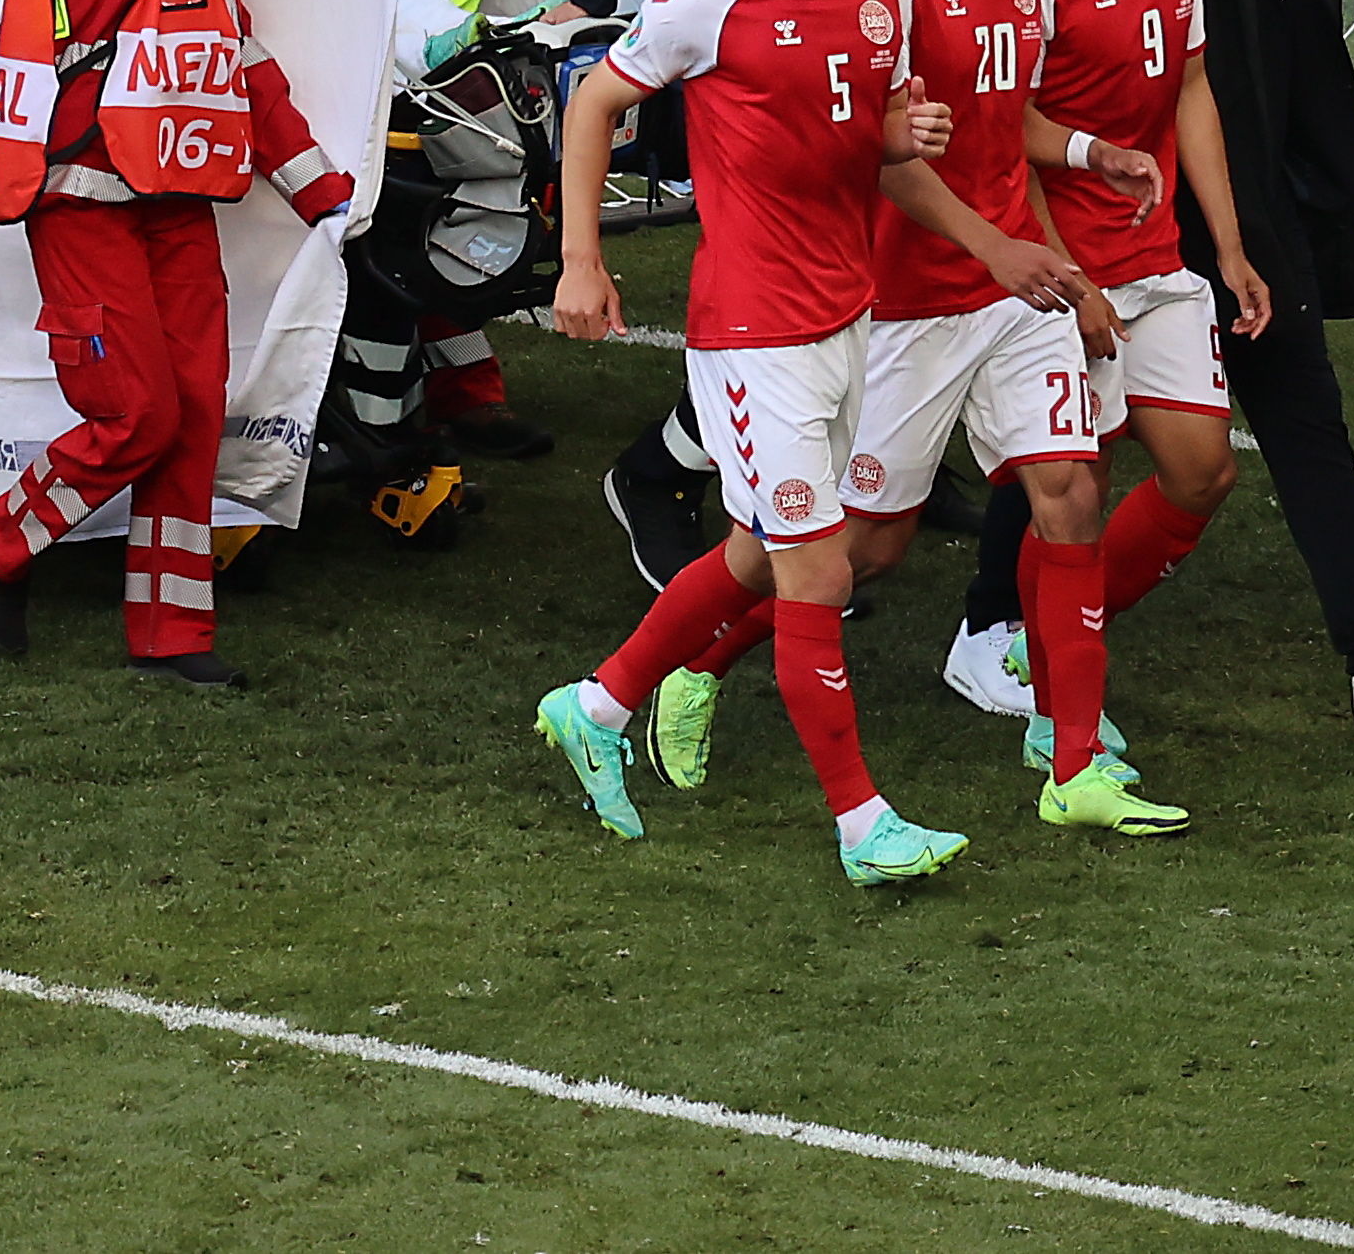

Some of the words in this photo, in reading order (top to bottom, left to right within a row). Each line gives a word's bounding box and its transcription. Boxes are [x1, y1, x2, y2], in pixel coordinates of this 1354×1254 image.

[974, 21, 1016, 94] 20
[1143, 8, 1165, 77] 9
[827, 53, 852, 122] 5
[780, 493, 807, 507] DBU
[857, 467, 877, 482] DBU
